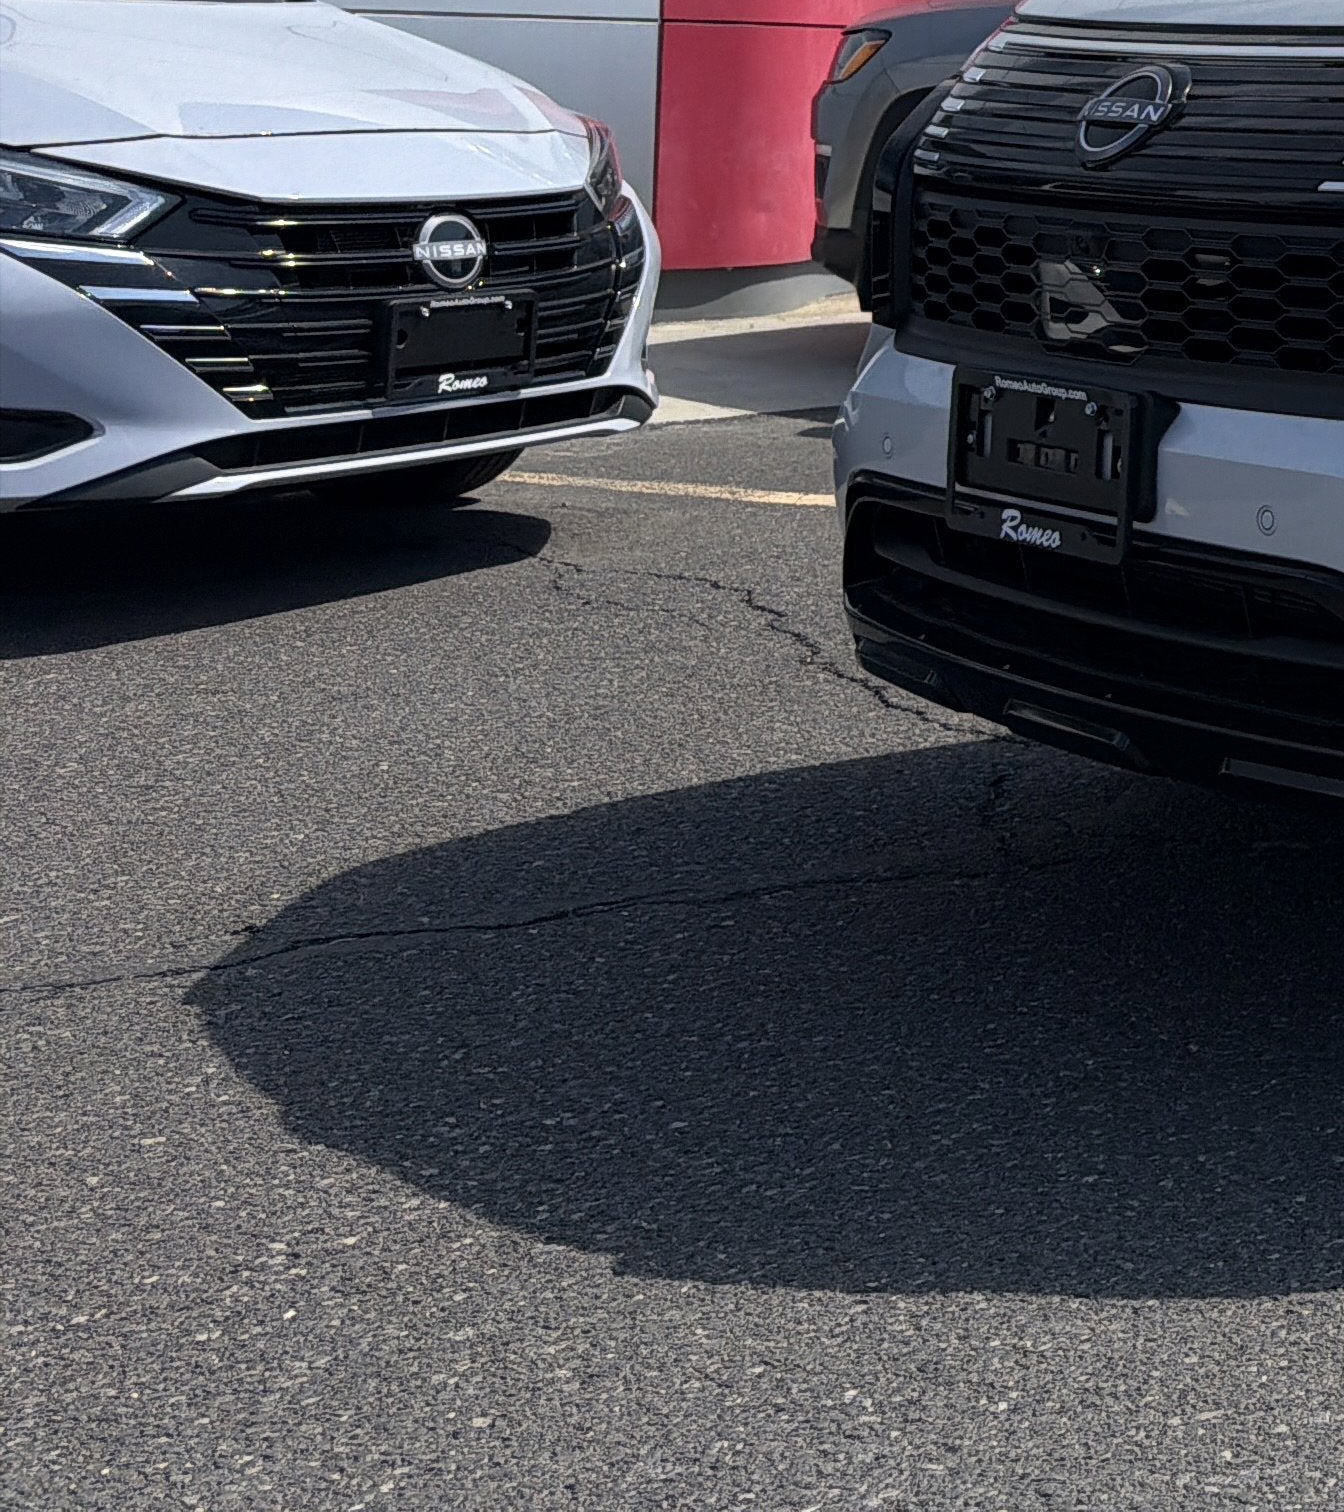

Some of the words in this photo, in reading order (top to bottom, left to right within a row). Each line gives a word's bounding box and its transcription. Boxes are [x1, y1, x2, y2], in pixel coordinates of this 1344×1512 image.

[415, 241, 486, 259] NISSAN
[438, 372, 488, 393] Romeo
[1000, 508, 1061, 548] Romeo
